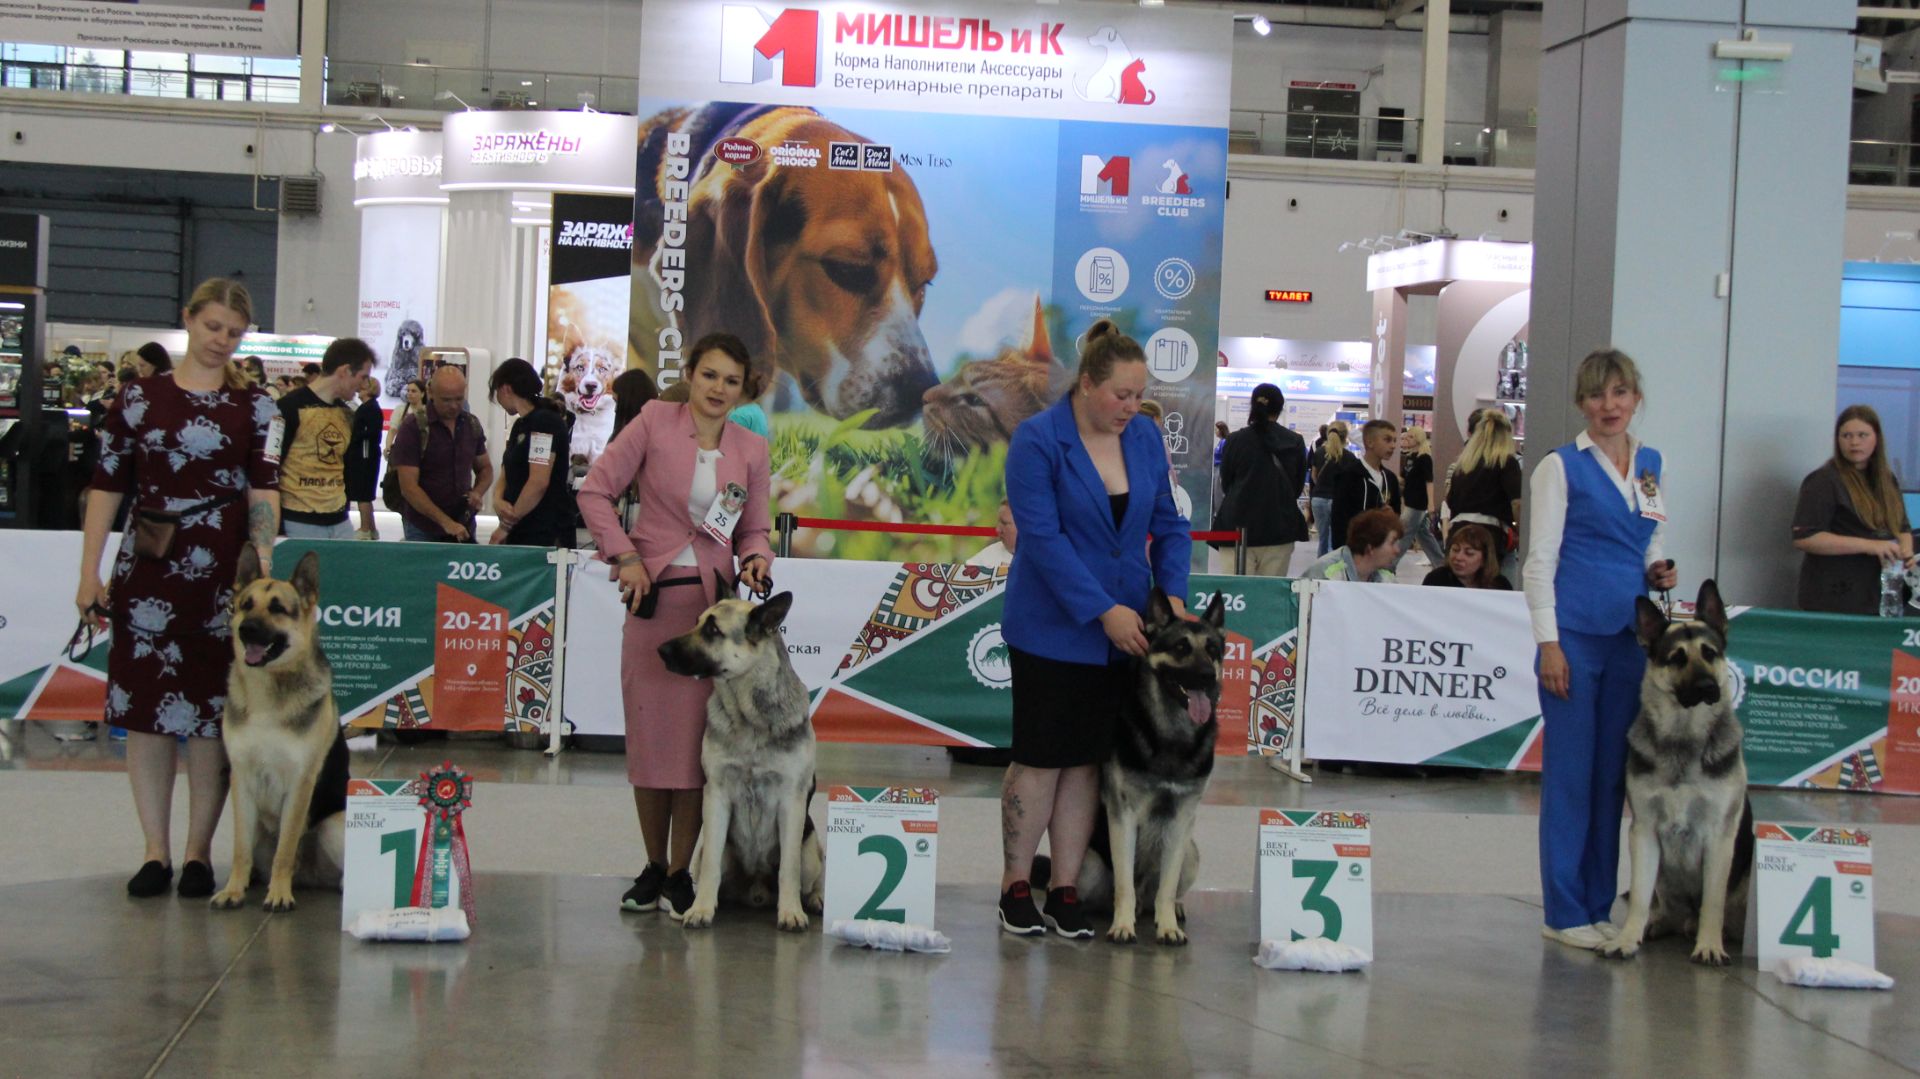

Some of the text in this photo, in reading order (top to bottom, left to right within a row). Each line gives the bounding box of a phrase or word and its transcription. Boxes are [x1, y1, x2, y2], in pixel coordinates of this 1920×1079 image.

[835, 11, 1065, 56] МИШЕЛЬ и К
[834, 51, 1062, 80] Корма Наполнители Аксессуары
[834, 73, 1064, 101] Ветеринарные препараты
[722, 142, 754, 153] Родные
[866, 148, 888, 160] Dog's
[724, 152, 751, 161] корма
[832, 156, 858, 167] Menu
[864, 157, 890, 168] Menu
[1142, 196, 1206, 208] BREEDERS
[1157, 207, 1189, 216] CLUB
[558, 236, 633, 250] НА АКТИВНОСТ
[657, 132, 690, 395] BREEDERS CLU
[1268, 290, 1310, 302] ТУАЛЕТ
[714, 512, 728, 527] 25
[448, 562, 502, 580] 2026
[315, 604, 402, 628] ССИЯ
[442, 611, 502, 630] 20-21
[445, 638, 500, 651] ИЮНЯ
[788, 645, 821, 654] ская
[1382, 638, 1473, 668] BEST
[1222, 668, 1244, 681] НЯ
[1753, 664, 1860, 690] РОССИЯ
[1353, 667, 1496, 700] DINNER
[1359, 696, 1390, 716] Всё
[1430, 704, 1438, 717] в
[353, 812, 378, 820] BEST
[834, 818, 856, 826] BEST
[346, 820, 384, 828] DINNER
[826, 826, 862, 834] DINNER
[1266, 842, 1289, 850] BEST
[1260, 848, 1296, 858] DINNER
[1764, 855, 1788, 864] BEST
[380, 828, 417, 910] 1
[1757, 862, 1794, 872] DINNER
[854, 834, 908, 924] 2
[1291, 860, 1342, 942] 3
[1779, 876, 1840, 958] 4
